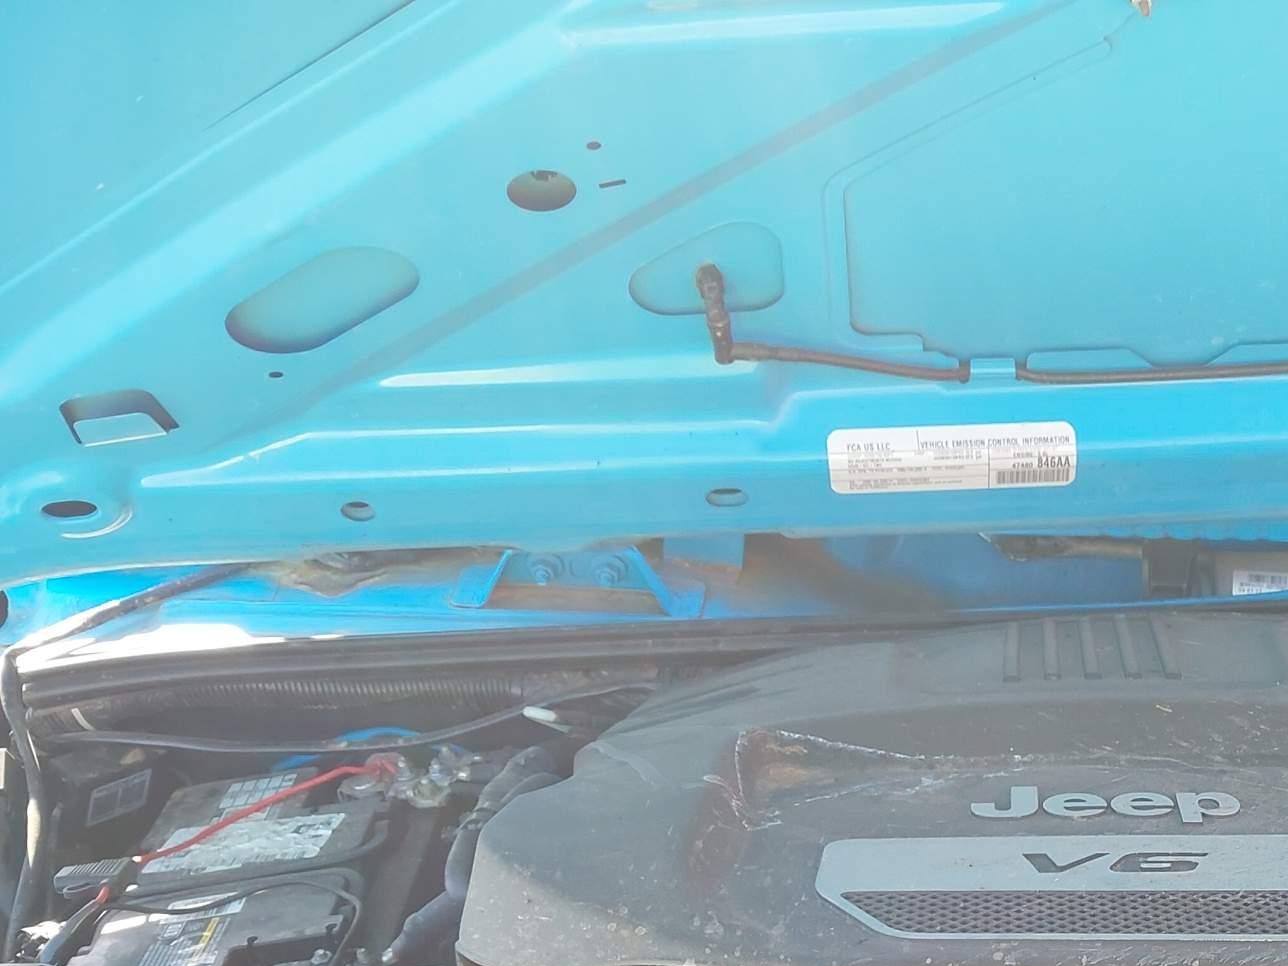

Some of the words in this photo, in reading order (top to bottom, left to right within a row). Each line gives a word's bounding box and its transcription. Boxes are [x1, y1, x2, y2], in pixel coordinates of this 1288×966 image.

[863, 442, 874, 451] US
[920, 440, 949, 449] VEHICLE
[951, 439, 986, 448] EMISSION
[988, 438, 1019, 447] CONTROL
[1022, 435, 1070, 446] INFORMATION
[969, 785, 1241, 823] Jeep
[1022, 852, 1209, 874] V6
